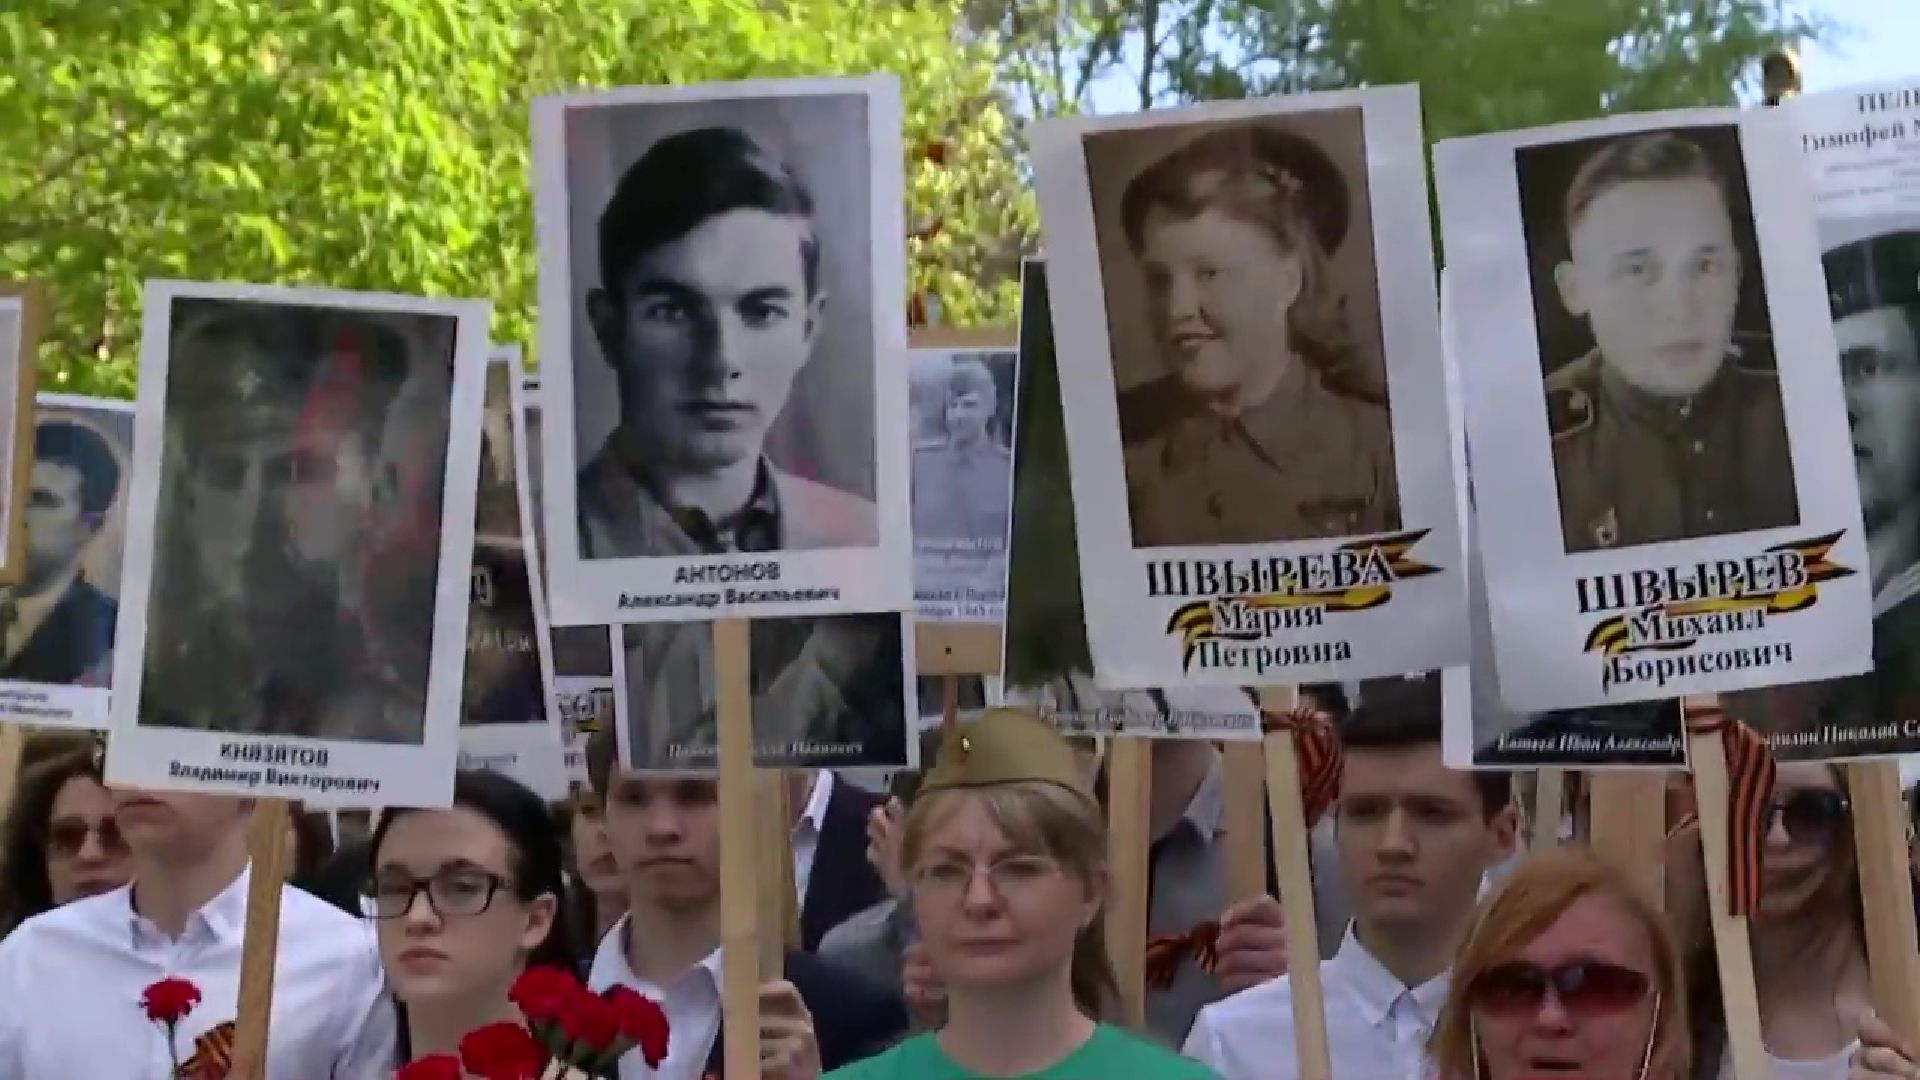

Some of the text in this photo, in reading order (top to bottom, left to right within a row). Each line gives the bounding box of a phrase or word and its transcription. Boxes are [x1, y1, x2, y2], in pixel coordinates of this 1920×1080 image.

[674, 561, 781, 584] АНТОНОВ
[1147, 543, 1395, 596] ШВЫРЕВА
[1576, 552, 1807, 614] ШВЫРЕВ
[618, 588, 839, 609] Александр Васильевич
[1217, 602, 1323, 638] Мария
[1630, 609, 1766, 643] Михаил
[1198, 640, 1352, 675] Петровна
[1610, 642, 1793, 688] Борисович
[220, 742, 328, 768] КНЯЗЯТОВ
[170, 760, 380, 794] Владимир Викторович
